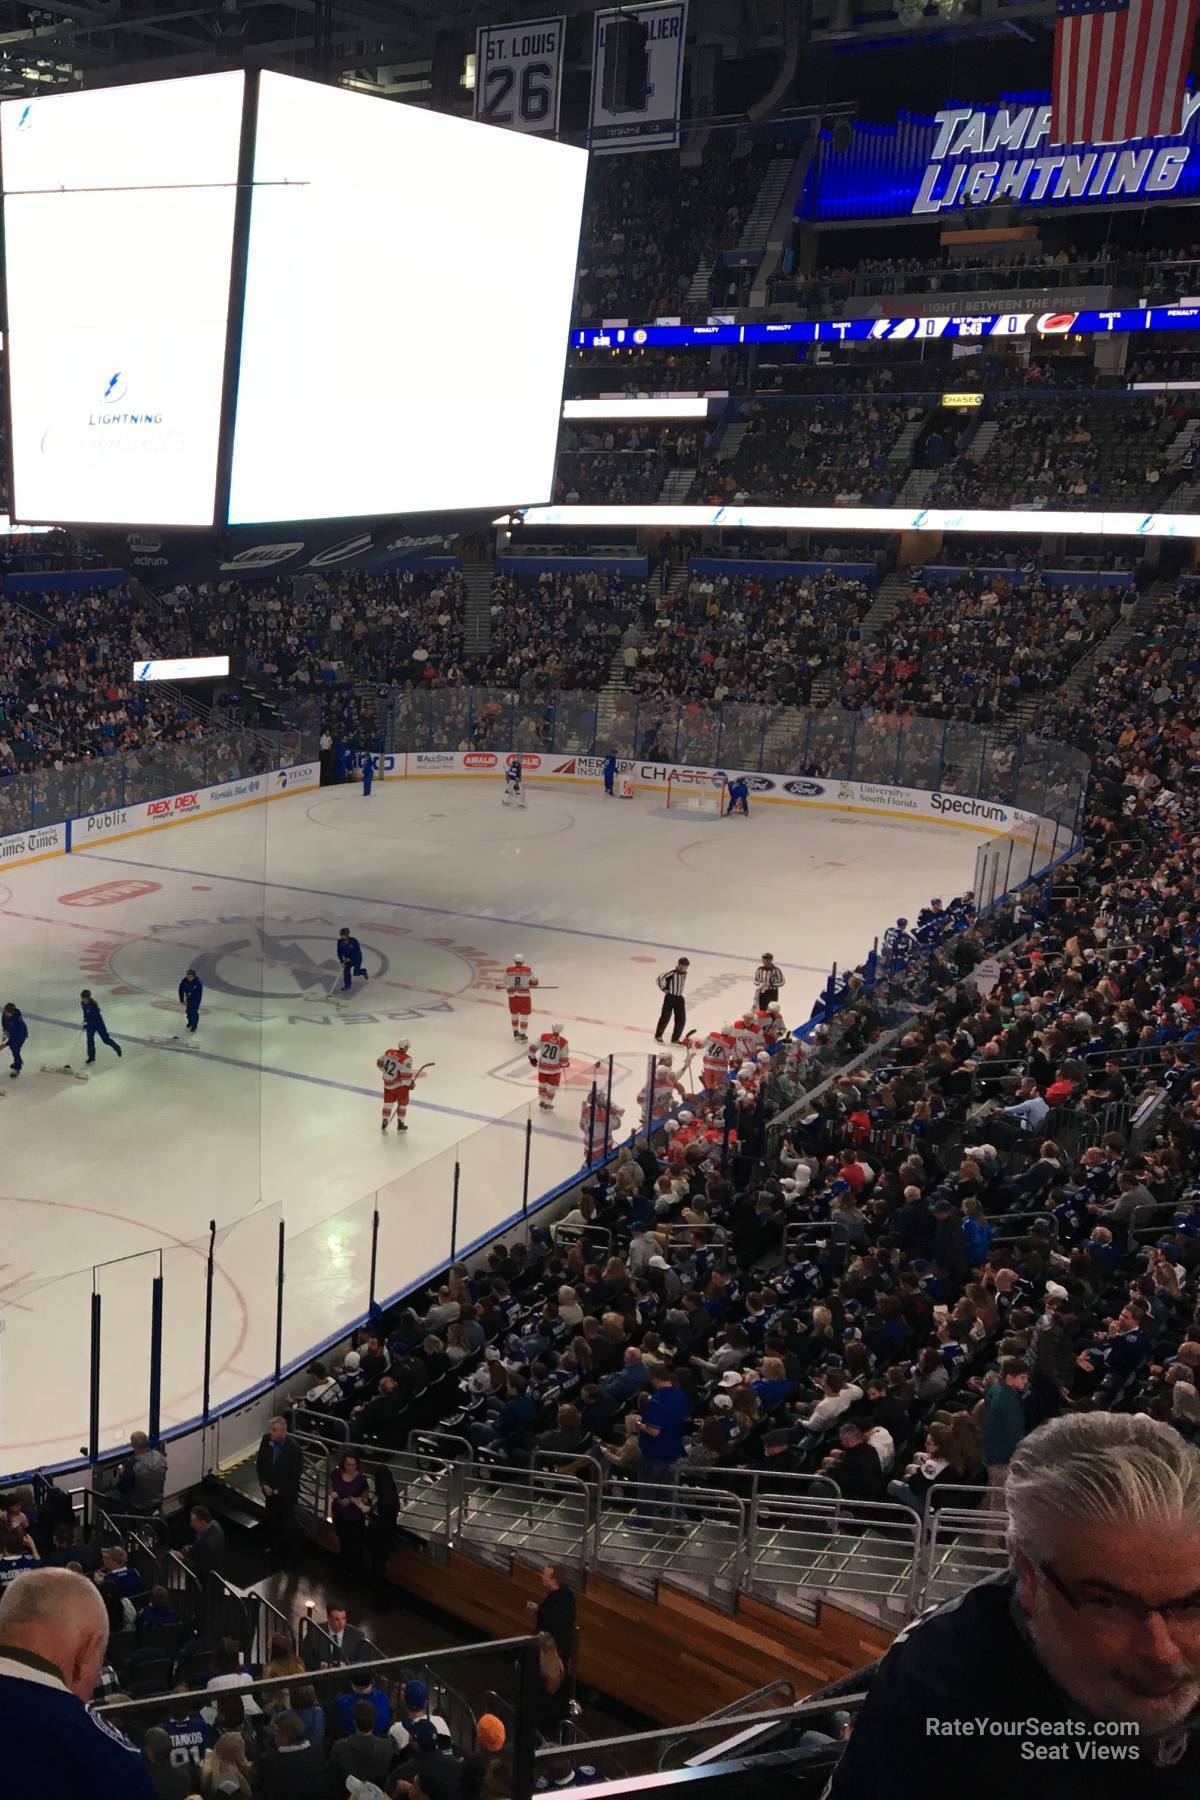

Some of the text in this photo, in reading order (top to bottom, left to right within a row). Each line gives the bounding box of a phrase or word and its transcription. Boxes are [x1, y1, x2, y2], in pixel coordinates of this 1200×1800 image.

[486, 32, 555, 60] ST. LOUIS
[485, 61, 553, 125] 26
[912, 147, 1190, 214] LIGHTNING
[923, 302, 957, 314] LIGHT
[965, 299, 1022, 312] BETWEEN
[1025, 298, 1048, 309] THE
[1051, 296, 1087, 308] PIPES
[1167, 309, 1198, 318] PENALTY
[693, 326, 719, 334] PENALTY
[766, 324, 792, 332] PENALTY
[926, 319, 935, 336] 0
[1008, 316, 1017, 333] 0
[943, 395, 974, 404] CHASE
[88, 412, 163, 426] LIGHTNING
[790, 783, 816, 796] Ford
[860, 784, 903, 798] University
[146, 792, 199, 817] DEX DEX
[859, 793, 918, 809] South Florida
[930, 793, 1004, 821] Spectrum
[88, 810, 127, 832] Publix
[27, 833, 59, 850] Times
[540, 1043, 559, 1060] 20
[706, 1042, 722, 1057] 48
[383, 1059, 397, 1077] 42
